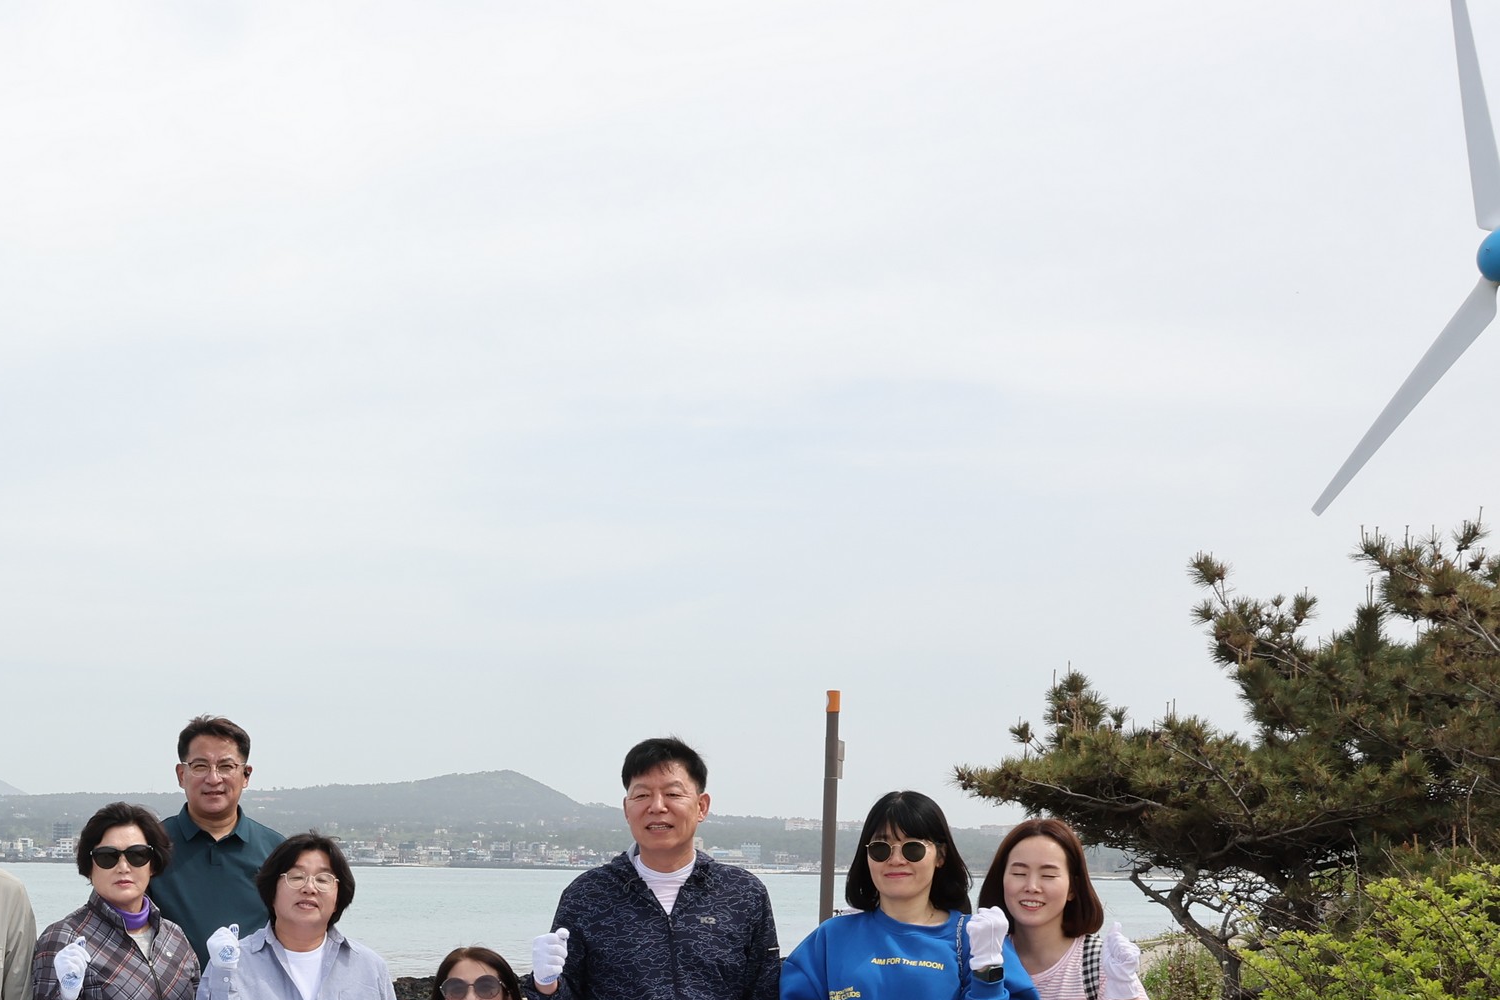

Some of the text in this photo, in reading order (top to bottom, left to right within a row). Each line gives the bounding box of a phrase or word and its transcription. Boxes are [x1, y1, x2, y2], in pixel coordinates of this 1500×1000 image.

[700, 916, 717, 925] K2
[871, 957, 944, 970] AIM FOR THE MOON
